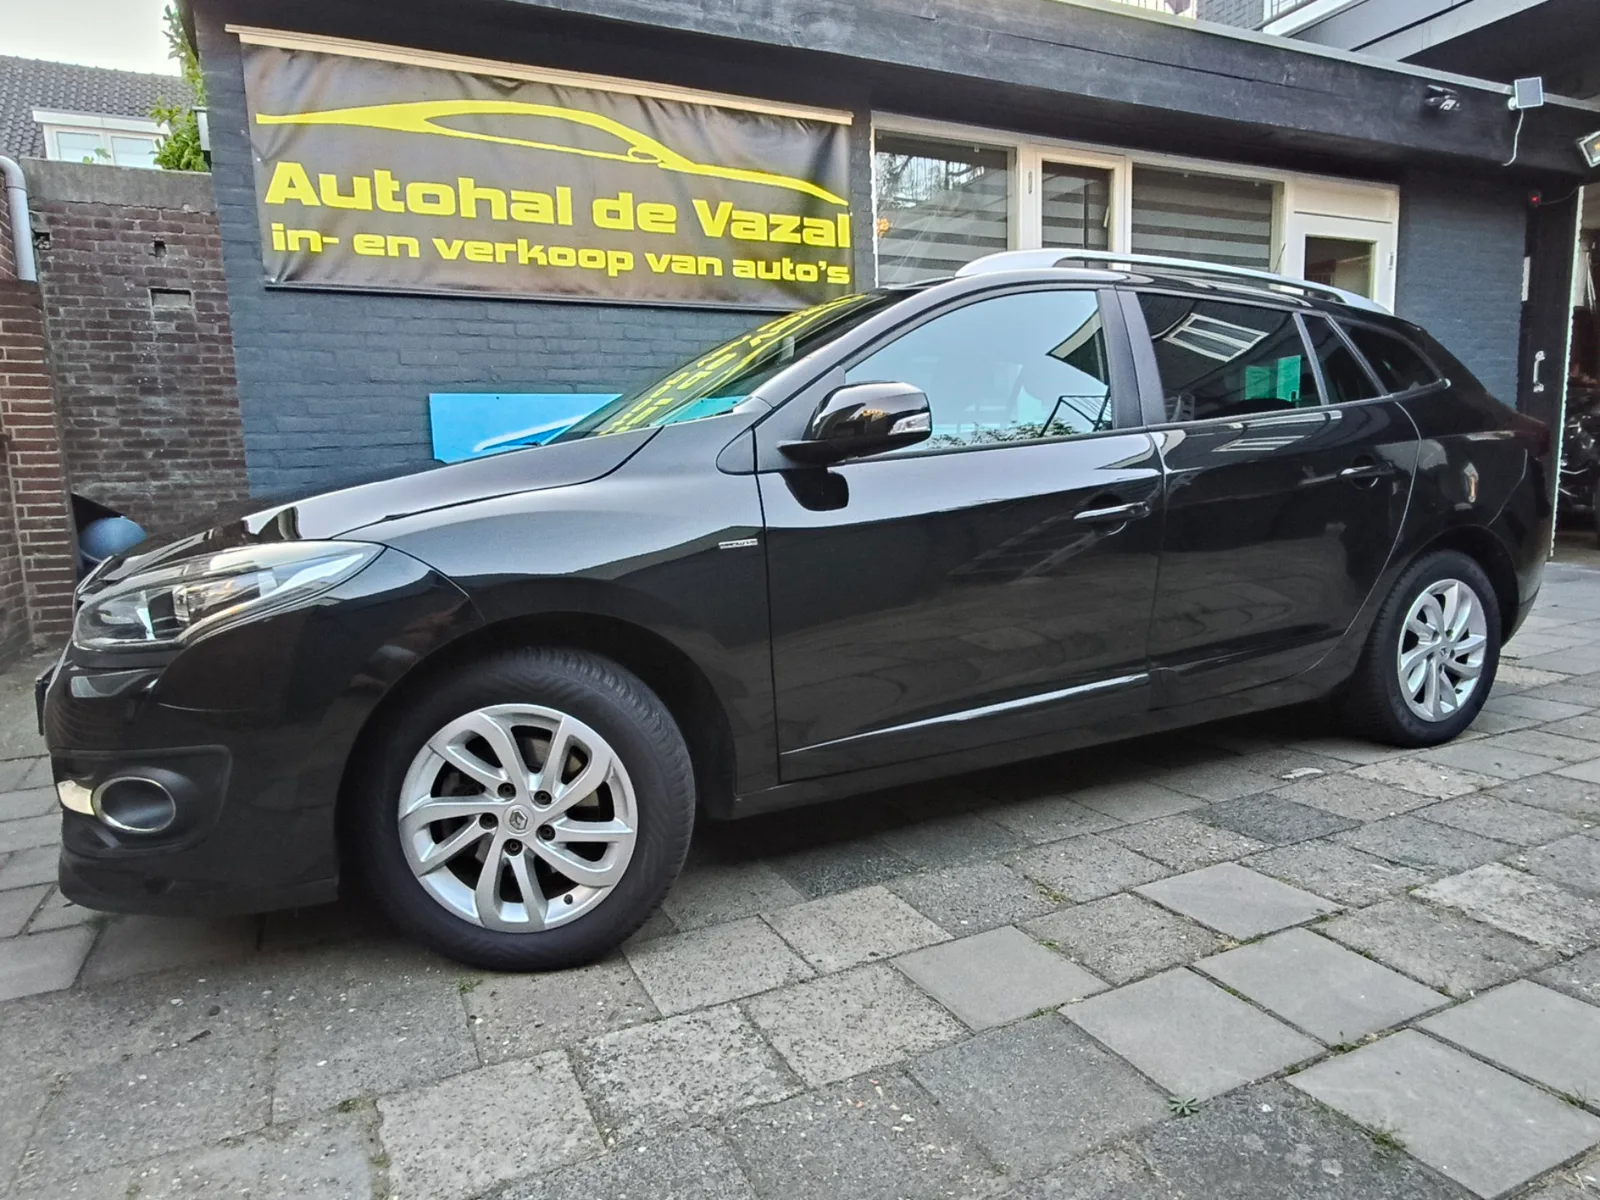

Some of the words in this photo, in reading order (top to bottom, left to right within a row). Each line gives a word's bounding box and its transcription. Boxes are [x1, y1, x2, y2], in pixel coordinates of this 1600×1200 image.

[265, 161, 573, 226] Autohal
[592, 191, 678, 236] de
[693, 199, 851, 249] Vazal
[271, 224, 339, 253] in-
[352, 234, 420, 259] en
[432, 238, 634, 277] verkoop
[644, 252, 724, 277] van
[733, 258, 851, 284] auto's
